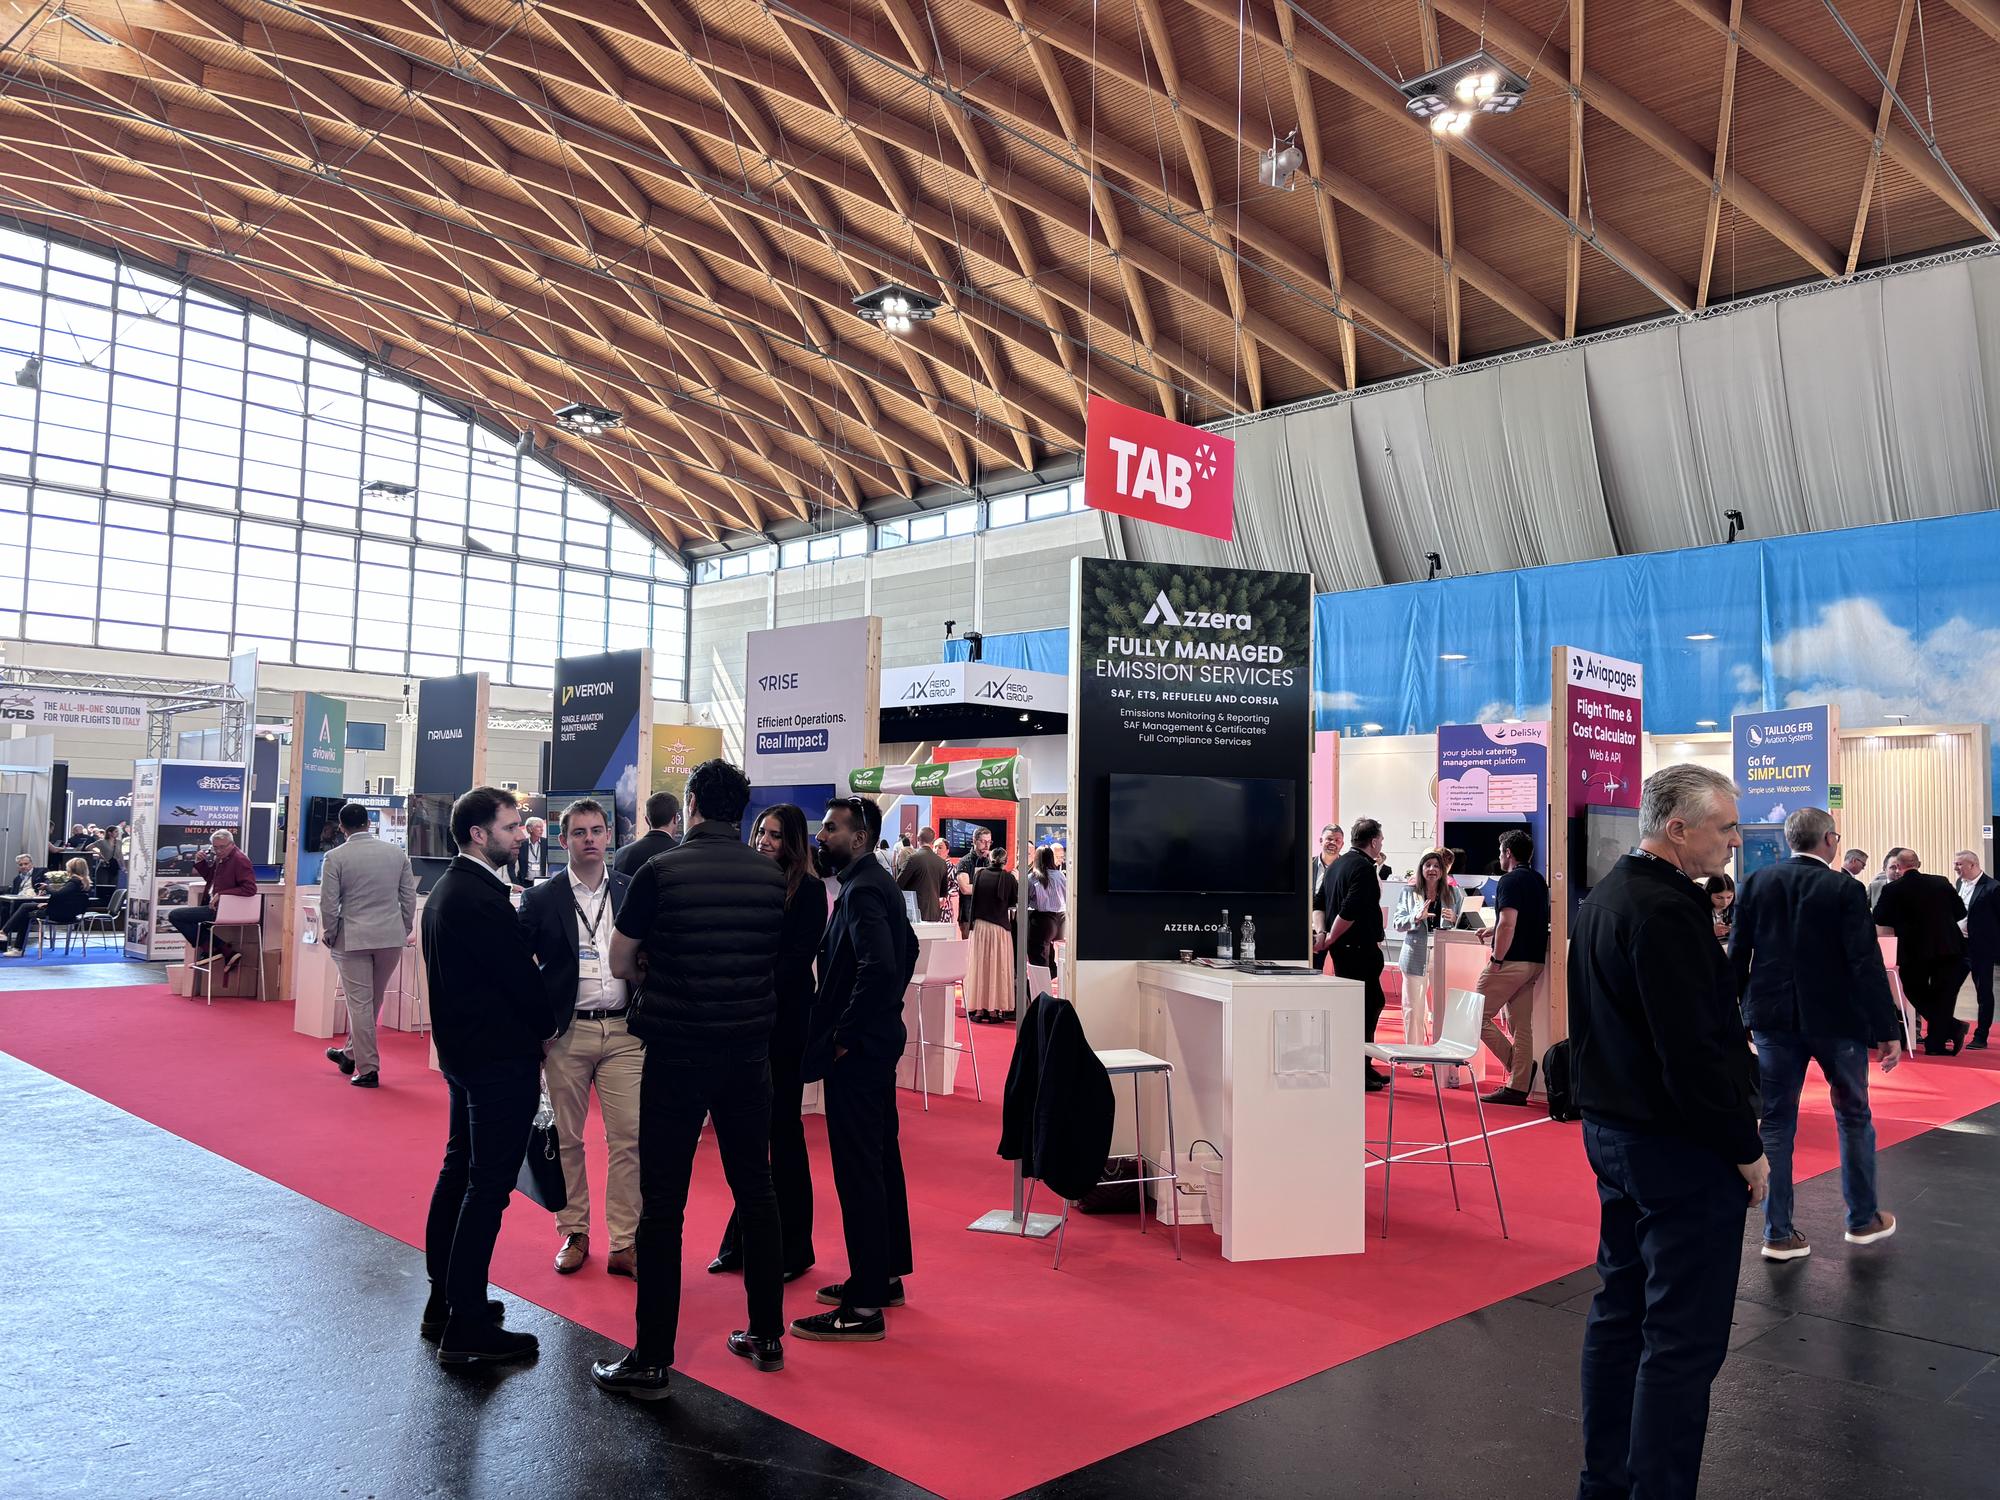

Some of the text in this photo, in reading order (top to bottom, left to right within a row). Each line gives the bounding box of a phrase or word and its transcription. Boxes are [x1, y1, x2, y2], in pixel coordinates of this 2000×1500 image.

[1109, 436, 1193, 509] TAB
[1107, 636, 1283, 663] FULLY MANAGED
[1096, 659, 1294, 687] EMISSION SERVICES
[1585, 656, 1637, 692] Aviapages
[574, 681, 614, 698] VERYON
[929, 679, 951, 688] AERO
[1006, 683, 1028, 692] AERO
[929, 688, 956, 698] GROUP
[1006, 692, 1034, 703] GROUP
[1110, 688, 1279, 705] SAF, ETS, REFUELEU AND CORSIA
[44, 701, 141, 716] THE ALL-IN-ONE SOLUTION
[1577, 699, 1633, 723] Flight Time &
[43, 712, 141, 726] FOR YOUR FLIGHTS TO ITALY
[561, 713, 604, 724] SINGLE AVIATION
[757, 712, 847, 728] Efficient Operations.
[1120, 708, 1270, 725] Emissions Monitoring & Reporting
[560, 723, 598, 733] MAINTENANCE
[1123, 721, 1267, 735] SAF Management & Certificates
[1510, 728, 1541, 738] DeliSky
[1572, 721, 1637, 745] Cost Calculator
[1764, 722, 1813, 736] TAILLOG EFB
[560, 732, 576, 742] SUITE
[759, 732, 826, 751] Real Impact.
[1138, 733, 1252, 746] Full Compliance Services
[1764, 733, 1814, 744] Aviation Systems
[1442, 747, 1518, 759] your global catering
[1589, 748, 1622, 763] Web & API
[671, 755, 685, 766] 360
[1442, 757, 1526, 767] management platform
[1748, 754, 1776, 766] Go for
[676, 767, 692, 775] FUEL
[1747, 764, 1812, 781] SIMPLICITY
[199, 781, 241, 790] SERVICES
[980, 777, 1009, 788] AERO
[77, 797, 113, 807] prince
[347, 797, 391, 807] CONCORDE
[1164, 924, 1226, 932] AZZERA.CO
